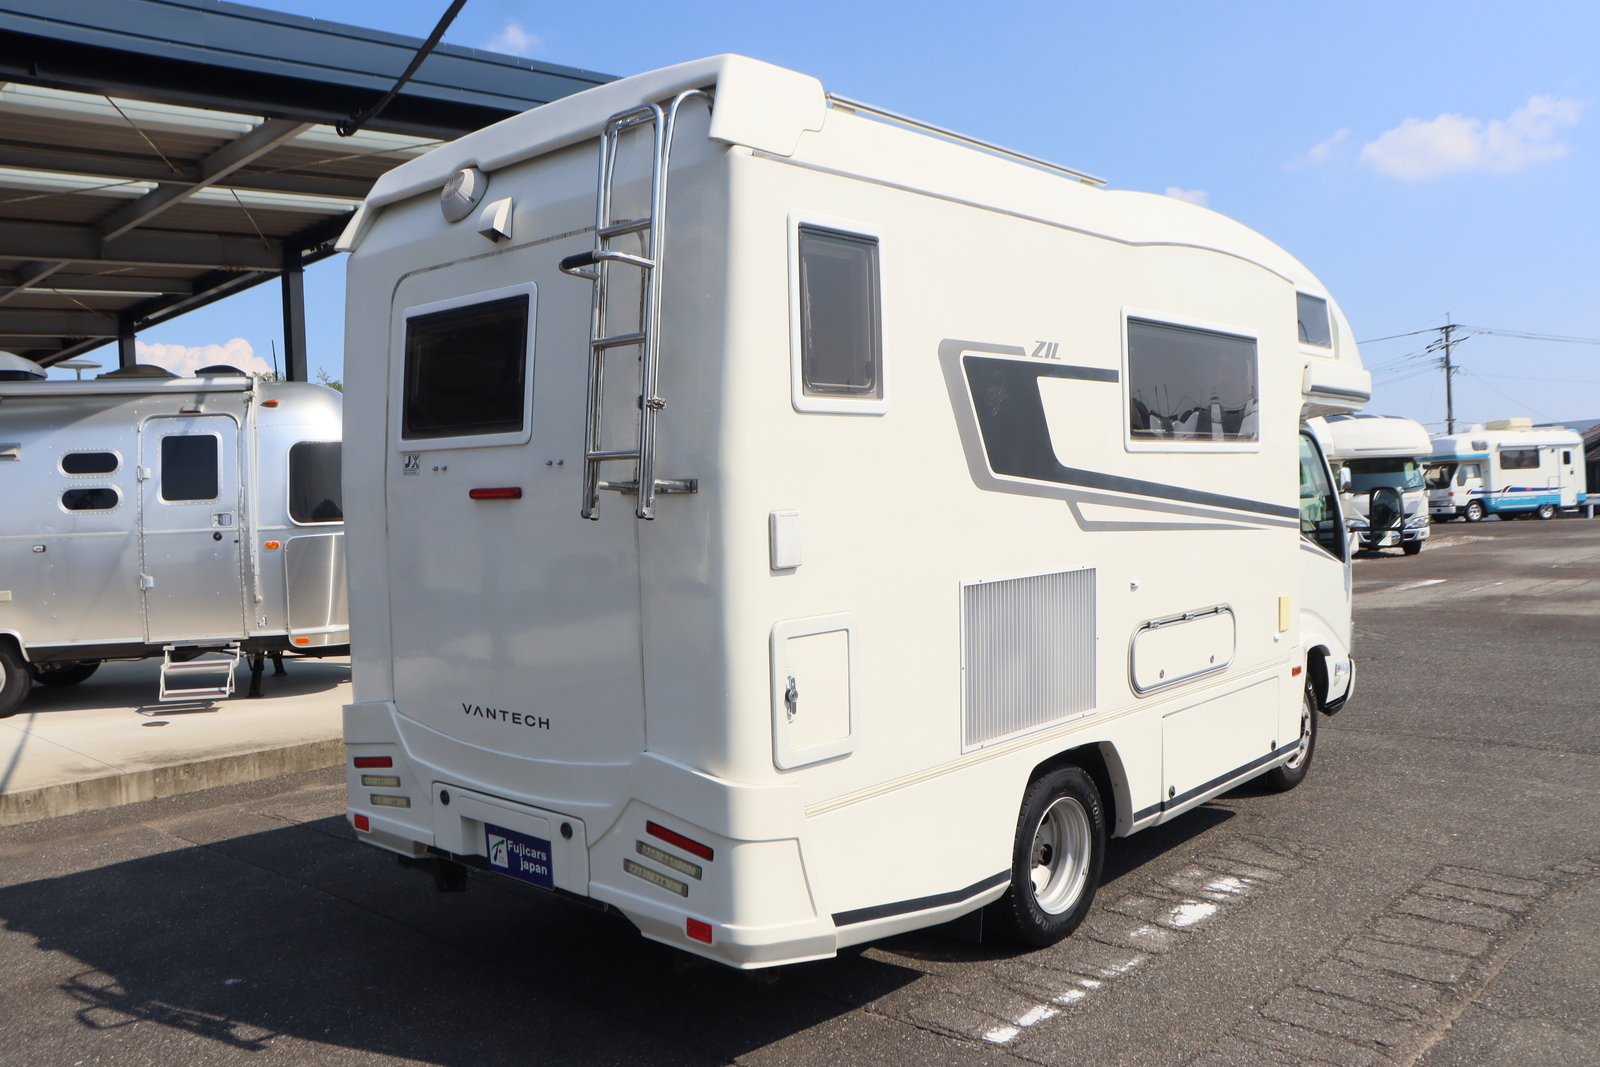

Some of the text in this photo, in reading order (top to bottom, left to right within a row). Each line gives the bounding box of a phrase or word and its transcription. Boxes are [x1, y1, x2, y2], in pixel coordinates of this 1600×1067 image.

[1031, 340, 1061, 360] ZIL
[462, 703, 550, 730] VANTECH
[507, 840, 547, 861] Fujicars
[520, 857, 548, 876] japan
